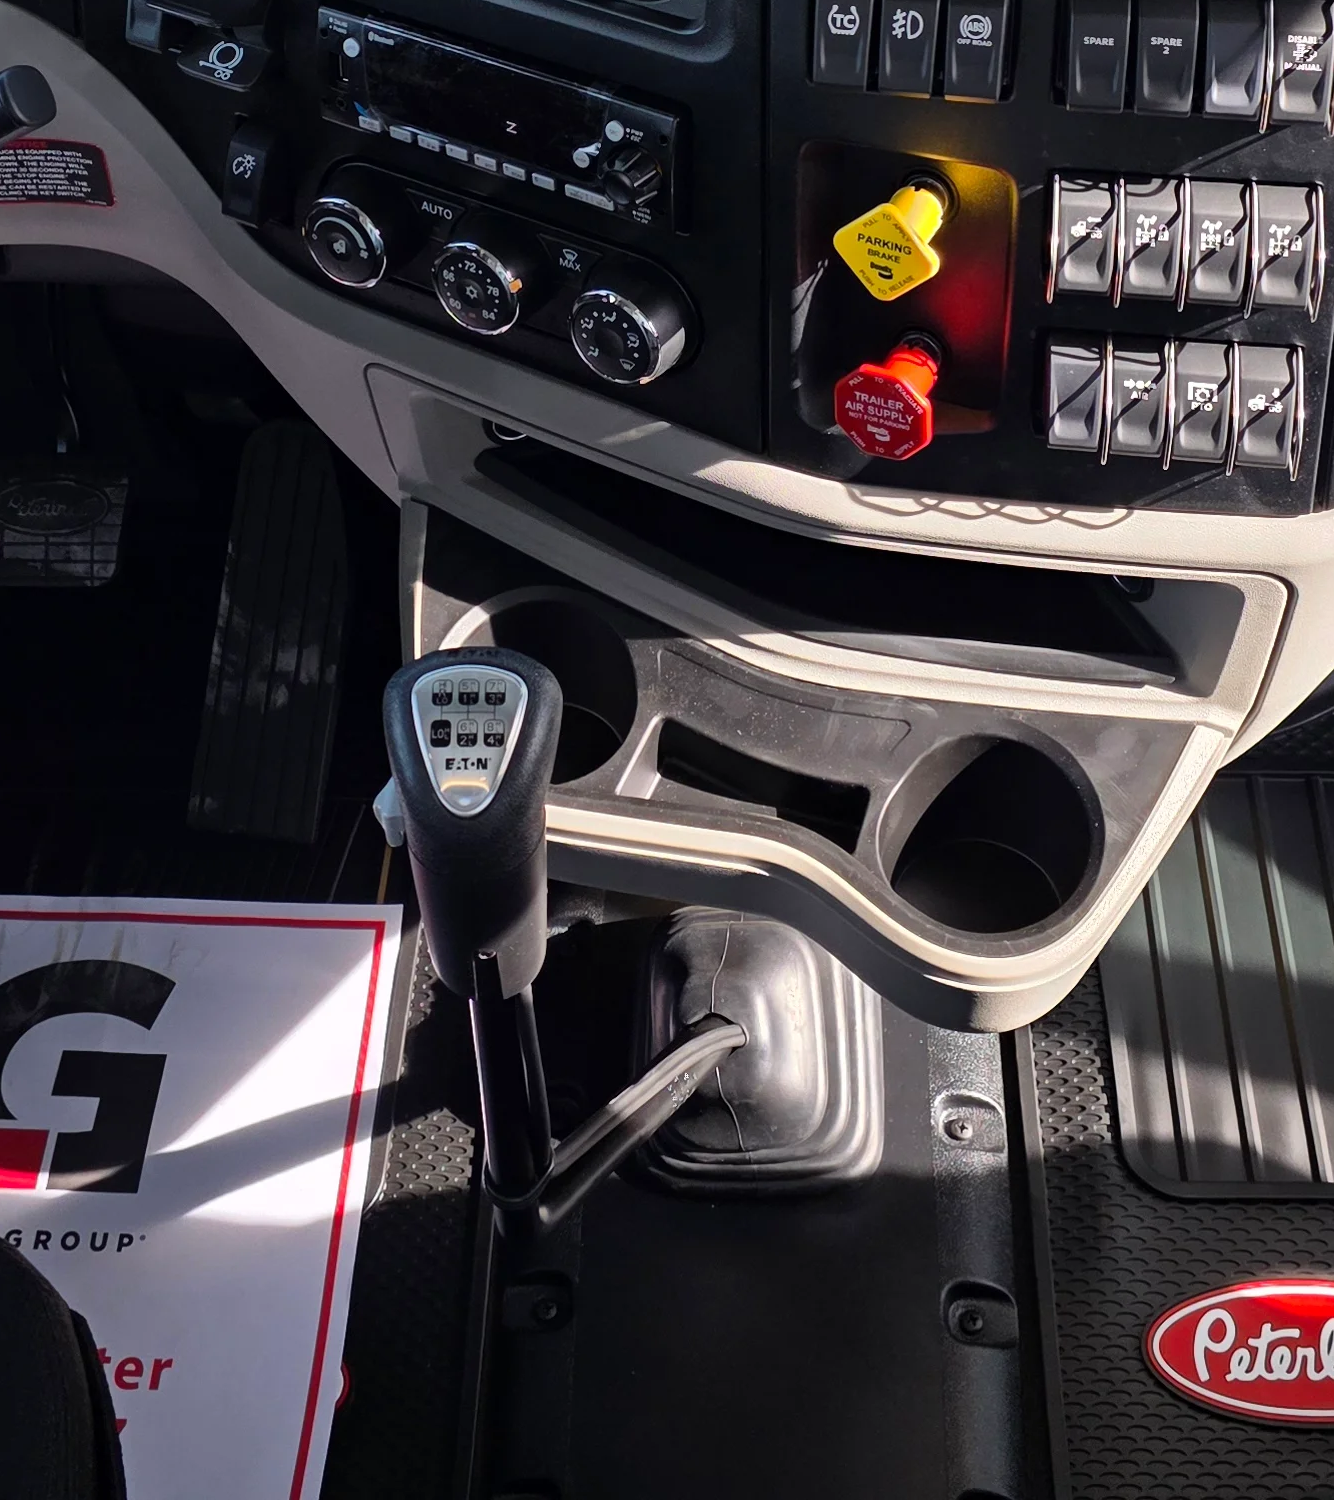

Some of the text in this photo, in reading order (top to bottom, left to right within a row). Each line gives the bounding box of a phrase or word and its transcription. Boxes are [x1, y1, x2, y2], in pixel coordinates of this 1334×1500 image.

[833, 13, 855, 28] TC
[967, 21, 986, 33] ABS
[956, 37, 993, 47] OFF ROAD
[1083, 36, 1114, 46] SPARE
[1150, 36, 1183, 47] SPARE
[1162, 46, 1170, 55] 2
[1283, 61, 1322, 72] MANUAL
[421, 200, 453, 220] AUTO
[857, 233, 912, 255] PARKING
[867, 248, 901, 264] BRAKE
[464, 260, 476, 273] 72
[559, 257, 582, 272] MAX
[442, 269, 455, 283] 66
[486, 285, 500, 297] 78
[482, 309, 496, 321] 84
[854, 391, 904, 412] TRAILER
[1131, 391, 1149, 401] AIR
[845, 400, 915, 425] AIR SUPPLY
[1191, 402, 1213, 412] PTO
[848, 411, 911, 431] NOT FOR PARKING
